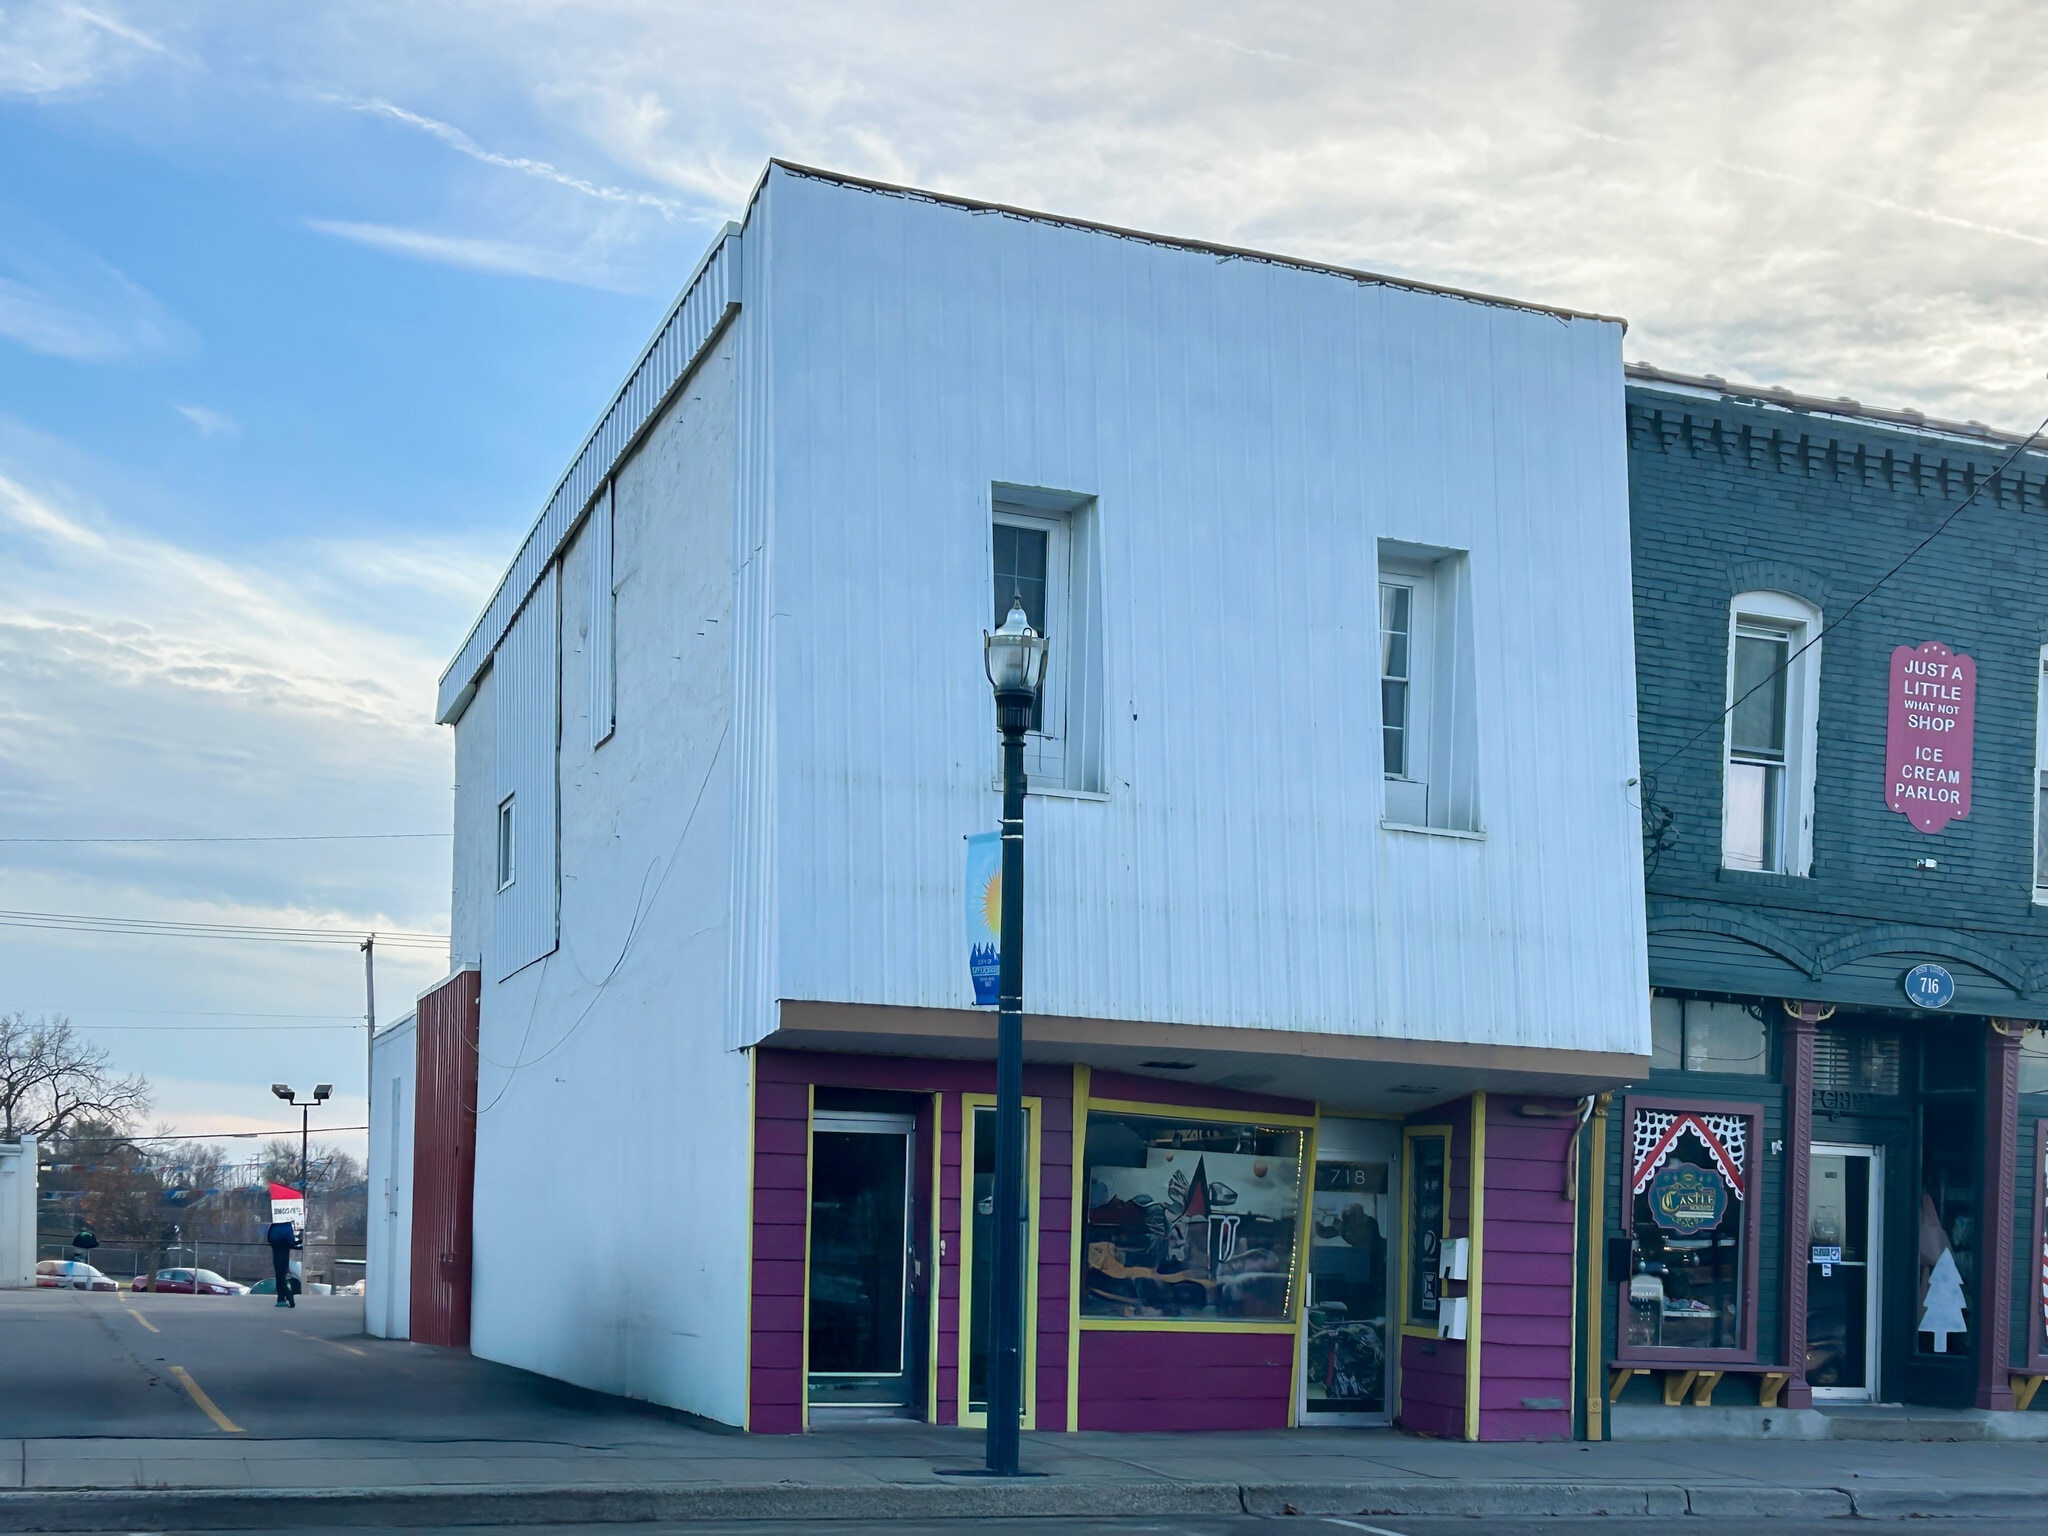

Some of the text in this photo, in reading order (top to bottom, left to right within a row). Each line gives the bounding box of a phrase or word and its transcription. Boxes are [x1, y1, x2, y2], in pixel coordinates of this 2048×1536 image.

[1904, 659, 1963, 681] JUST A
[1904, 680, 1962, 701] LITTLE
[1904, 699, 1960, 715] WHAT NOT
[1908, 714, 1955, 732] SHOP
[1915, 746, 1943, 763] ICE
[1902, 764, 1960, 784] CREAM
[1895, 783, 1960, 805] PARLOR
[1920, 977, 1939, 994] 716
[1330, 1169, 1366, 1185] 718
[1661, 1190, 1714, 1212] CASTLE
